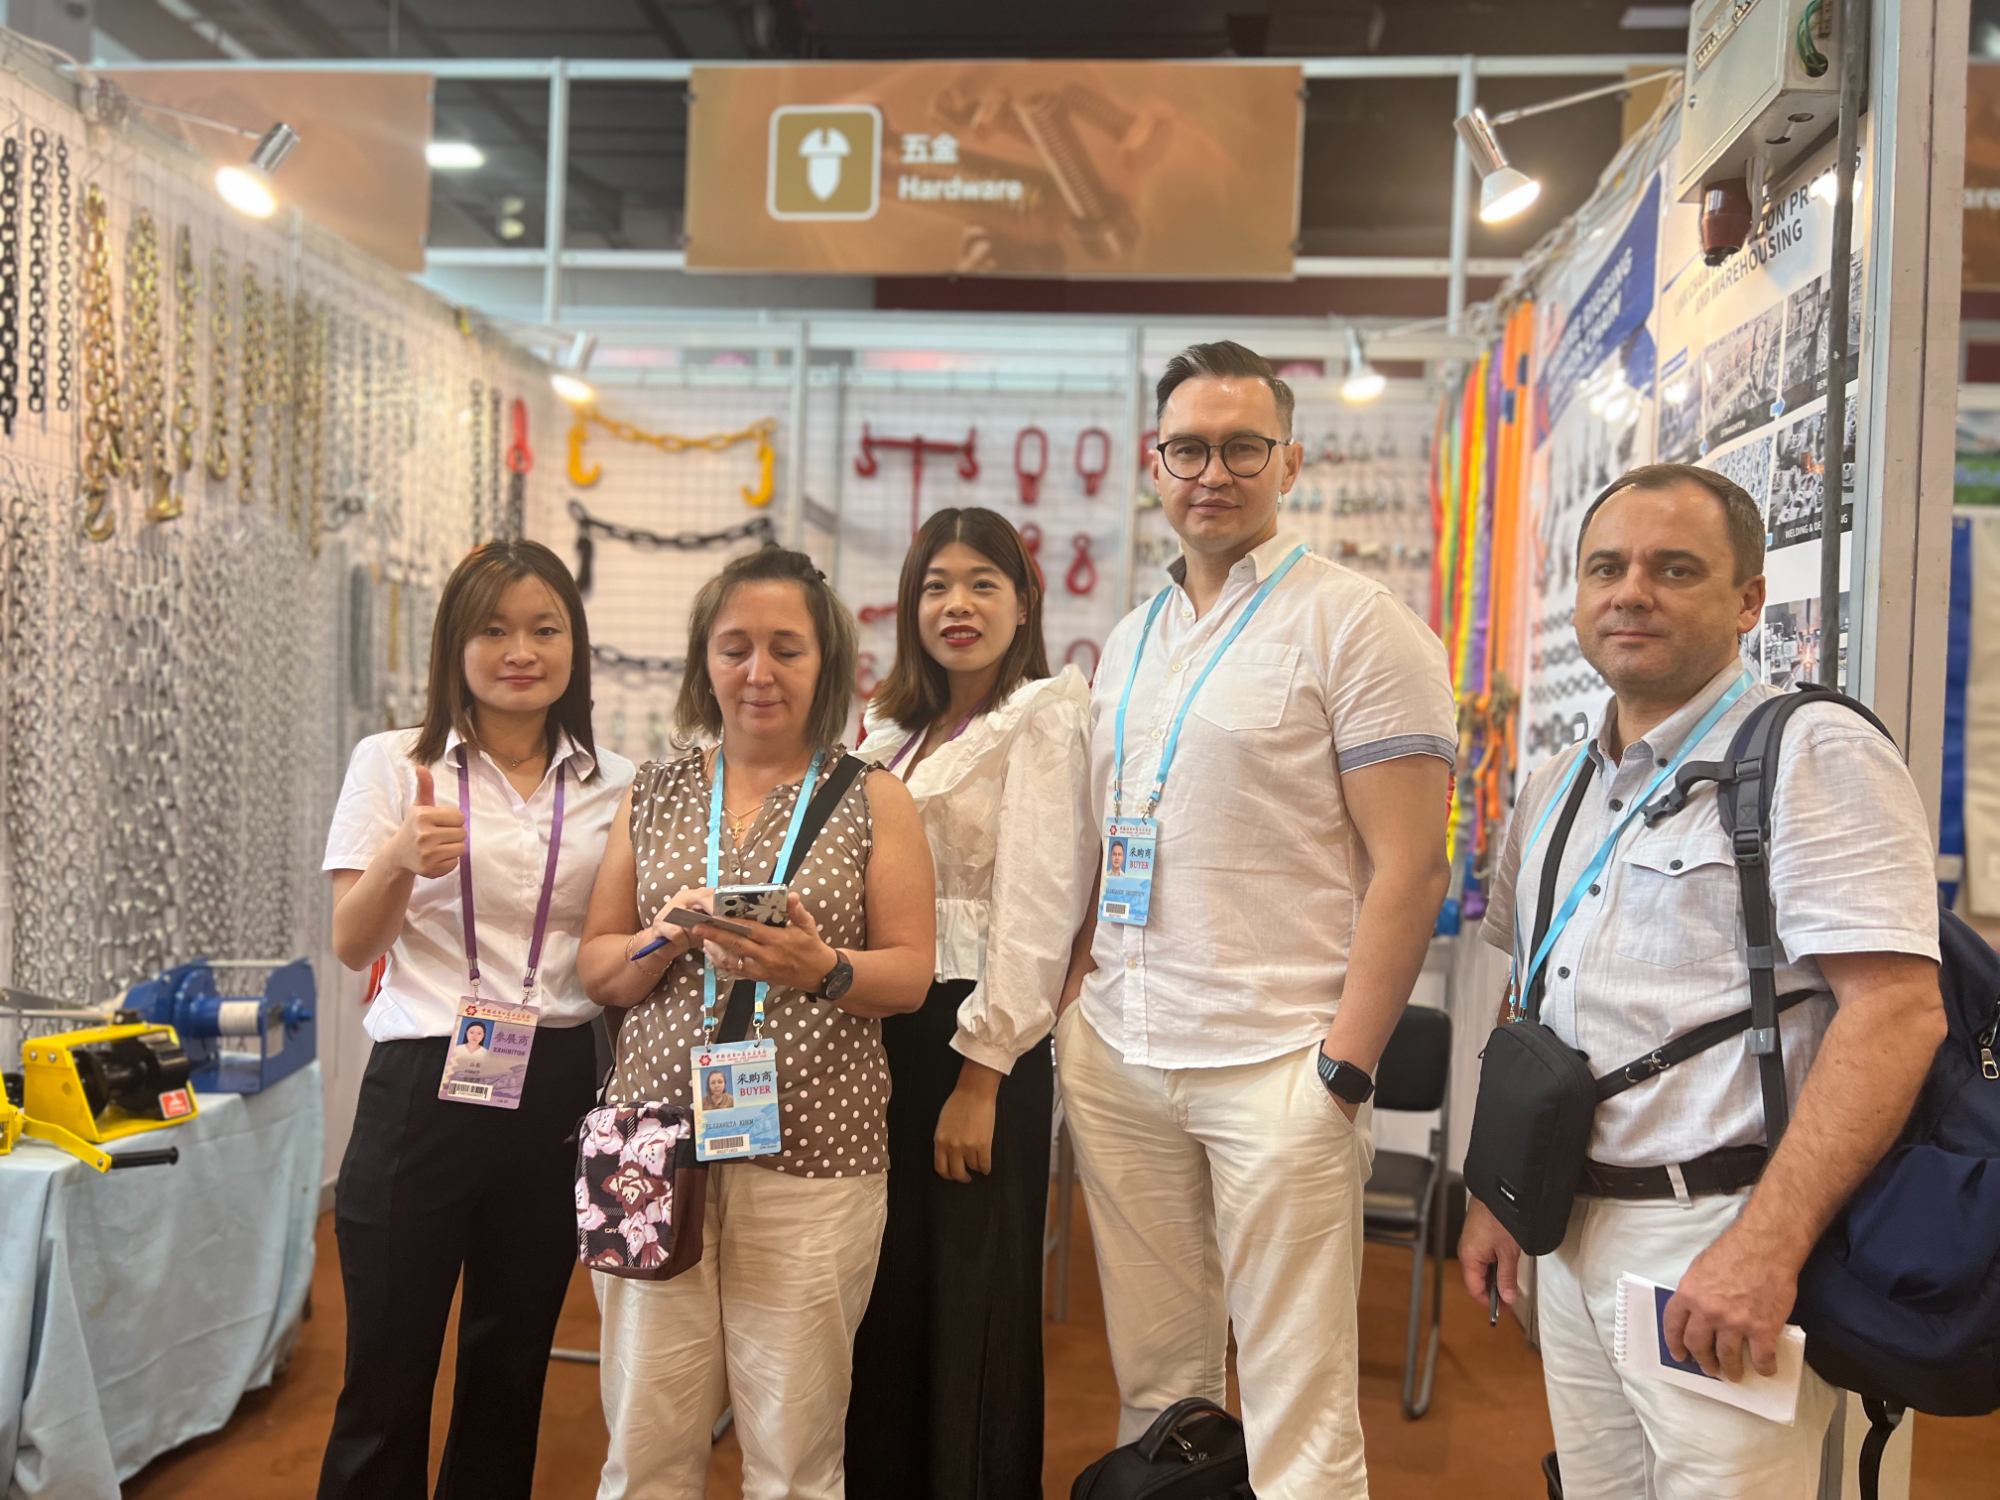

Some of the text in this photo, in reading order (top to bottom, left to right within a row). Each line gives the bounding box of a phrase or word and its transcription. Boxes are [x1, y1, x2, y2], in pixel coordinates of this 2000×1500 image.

[901, 133, 958, 164] 五金
[899, 176, 1022, 200] Hardware
[1712, 218, 1803, 300] WAREHOUSING
[1785, 524, 1808, 539] WELDING
[1130, 861, 1149, 870] BUYER
[493, 1047, 526, 1057] EXHIBITOR
[740, 1085, 771, 1097] BUYER
